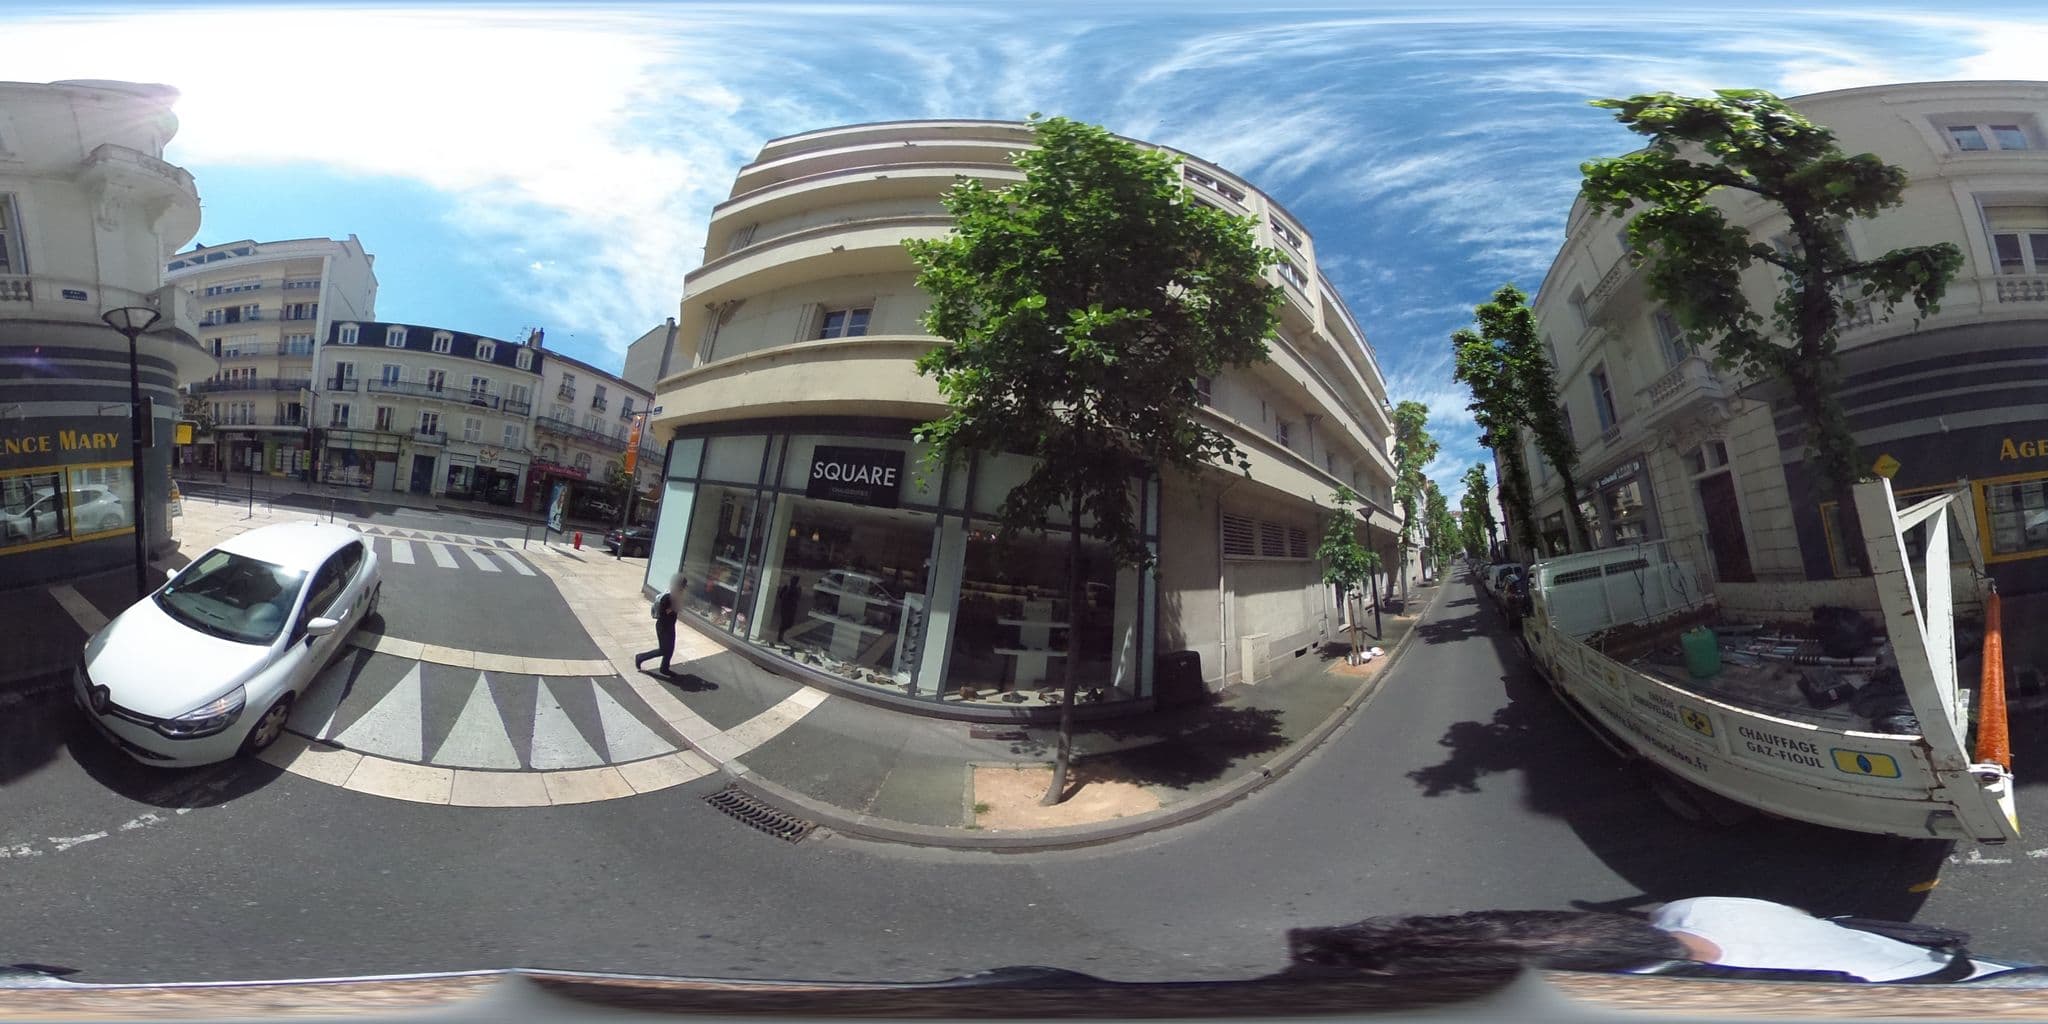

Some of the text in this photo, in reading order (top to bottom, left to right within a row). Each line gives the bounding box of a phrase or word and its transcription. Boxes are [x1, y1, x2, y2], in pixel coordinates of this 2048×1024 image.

[813, 461, 896, 487] SQUARE
[1738, 726, 1819, 756] CHAUFFAGE
[1746, 741, 1825, 769] GAZ-FIOUL
